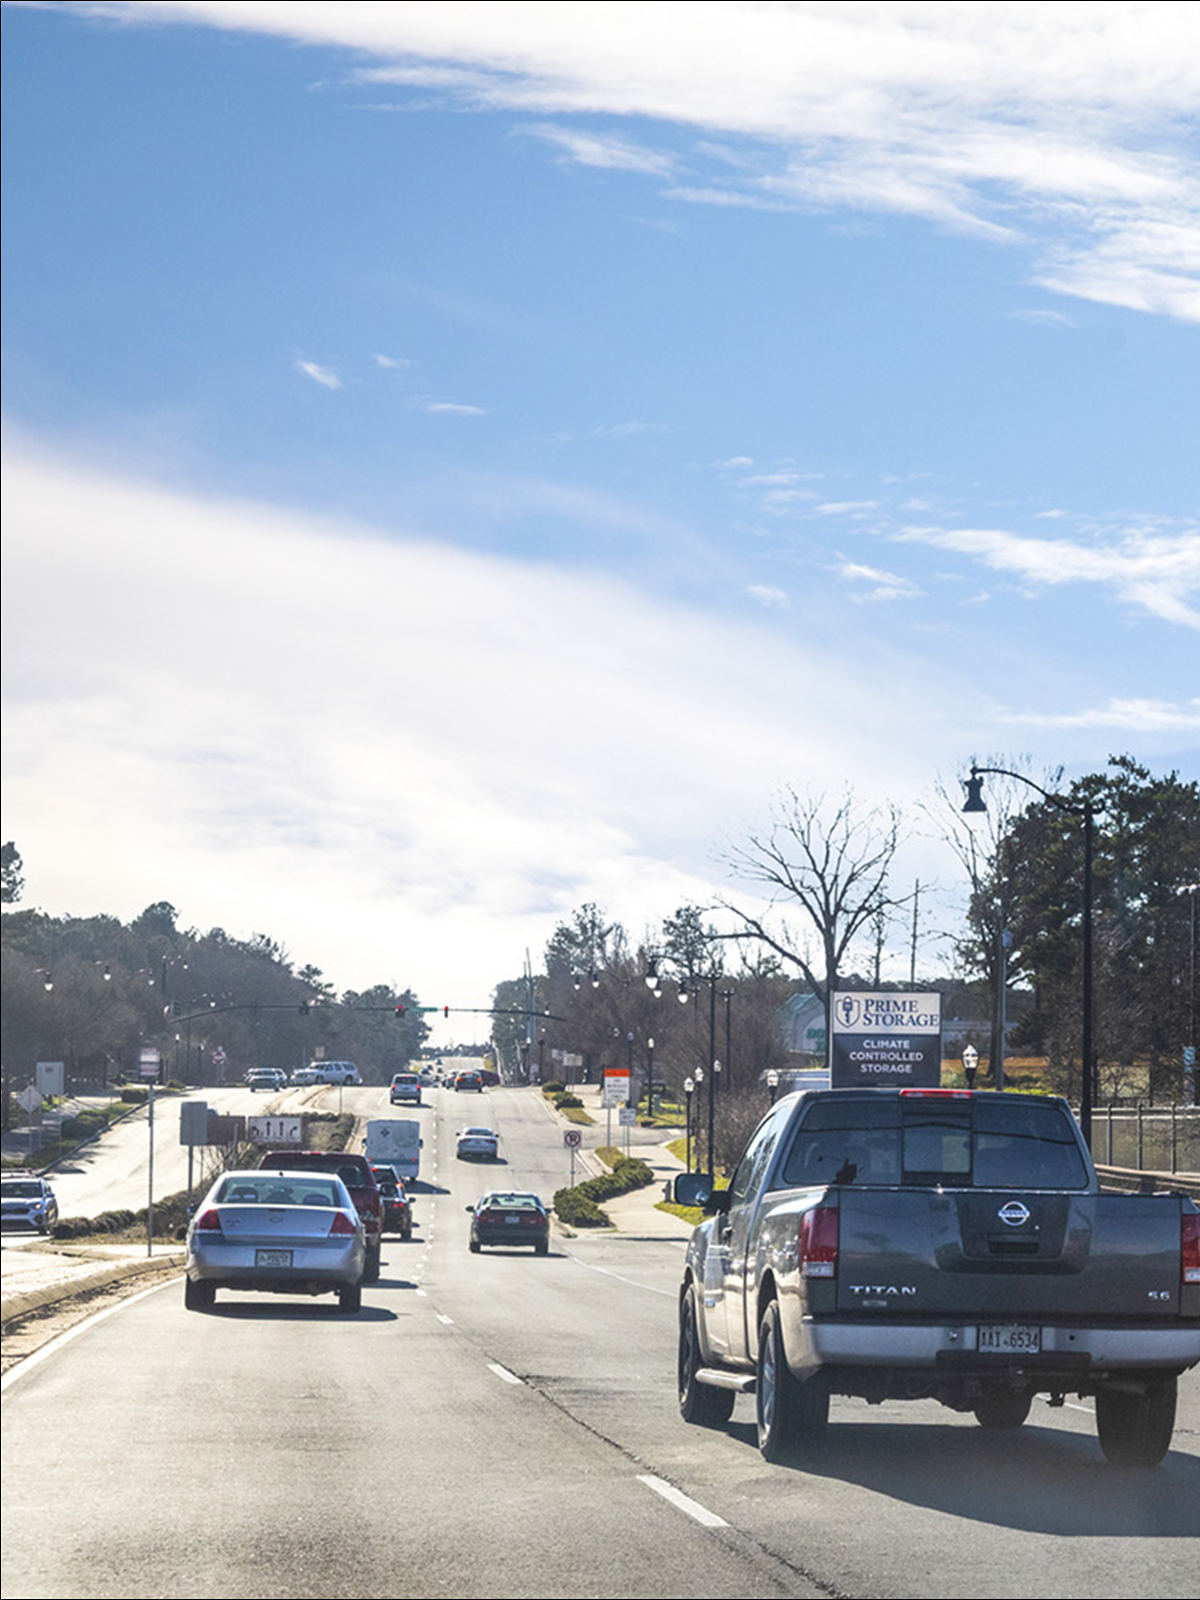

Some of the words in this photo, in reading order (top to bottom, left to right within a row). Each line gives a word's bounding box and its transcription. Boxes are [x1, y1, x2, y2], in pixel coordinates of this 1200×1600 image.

[864, 998, 919, 1013] PRIME
[862, 1012, 940, 1028] STORAGE
[862, 1039, 911, 1050] CLIMATE
[849, 1051, 924, 1062] CONTROLLED
[860, 1063, 912, 1074] STORAGE
[849, 1285, 916, 1296] TITAN
